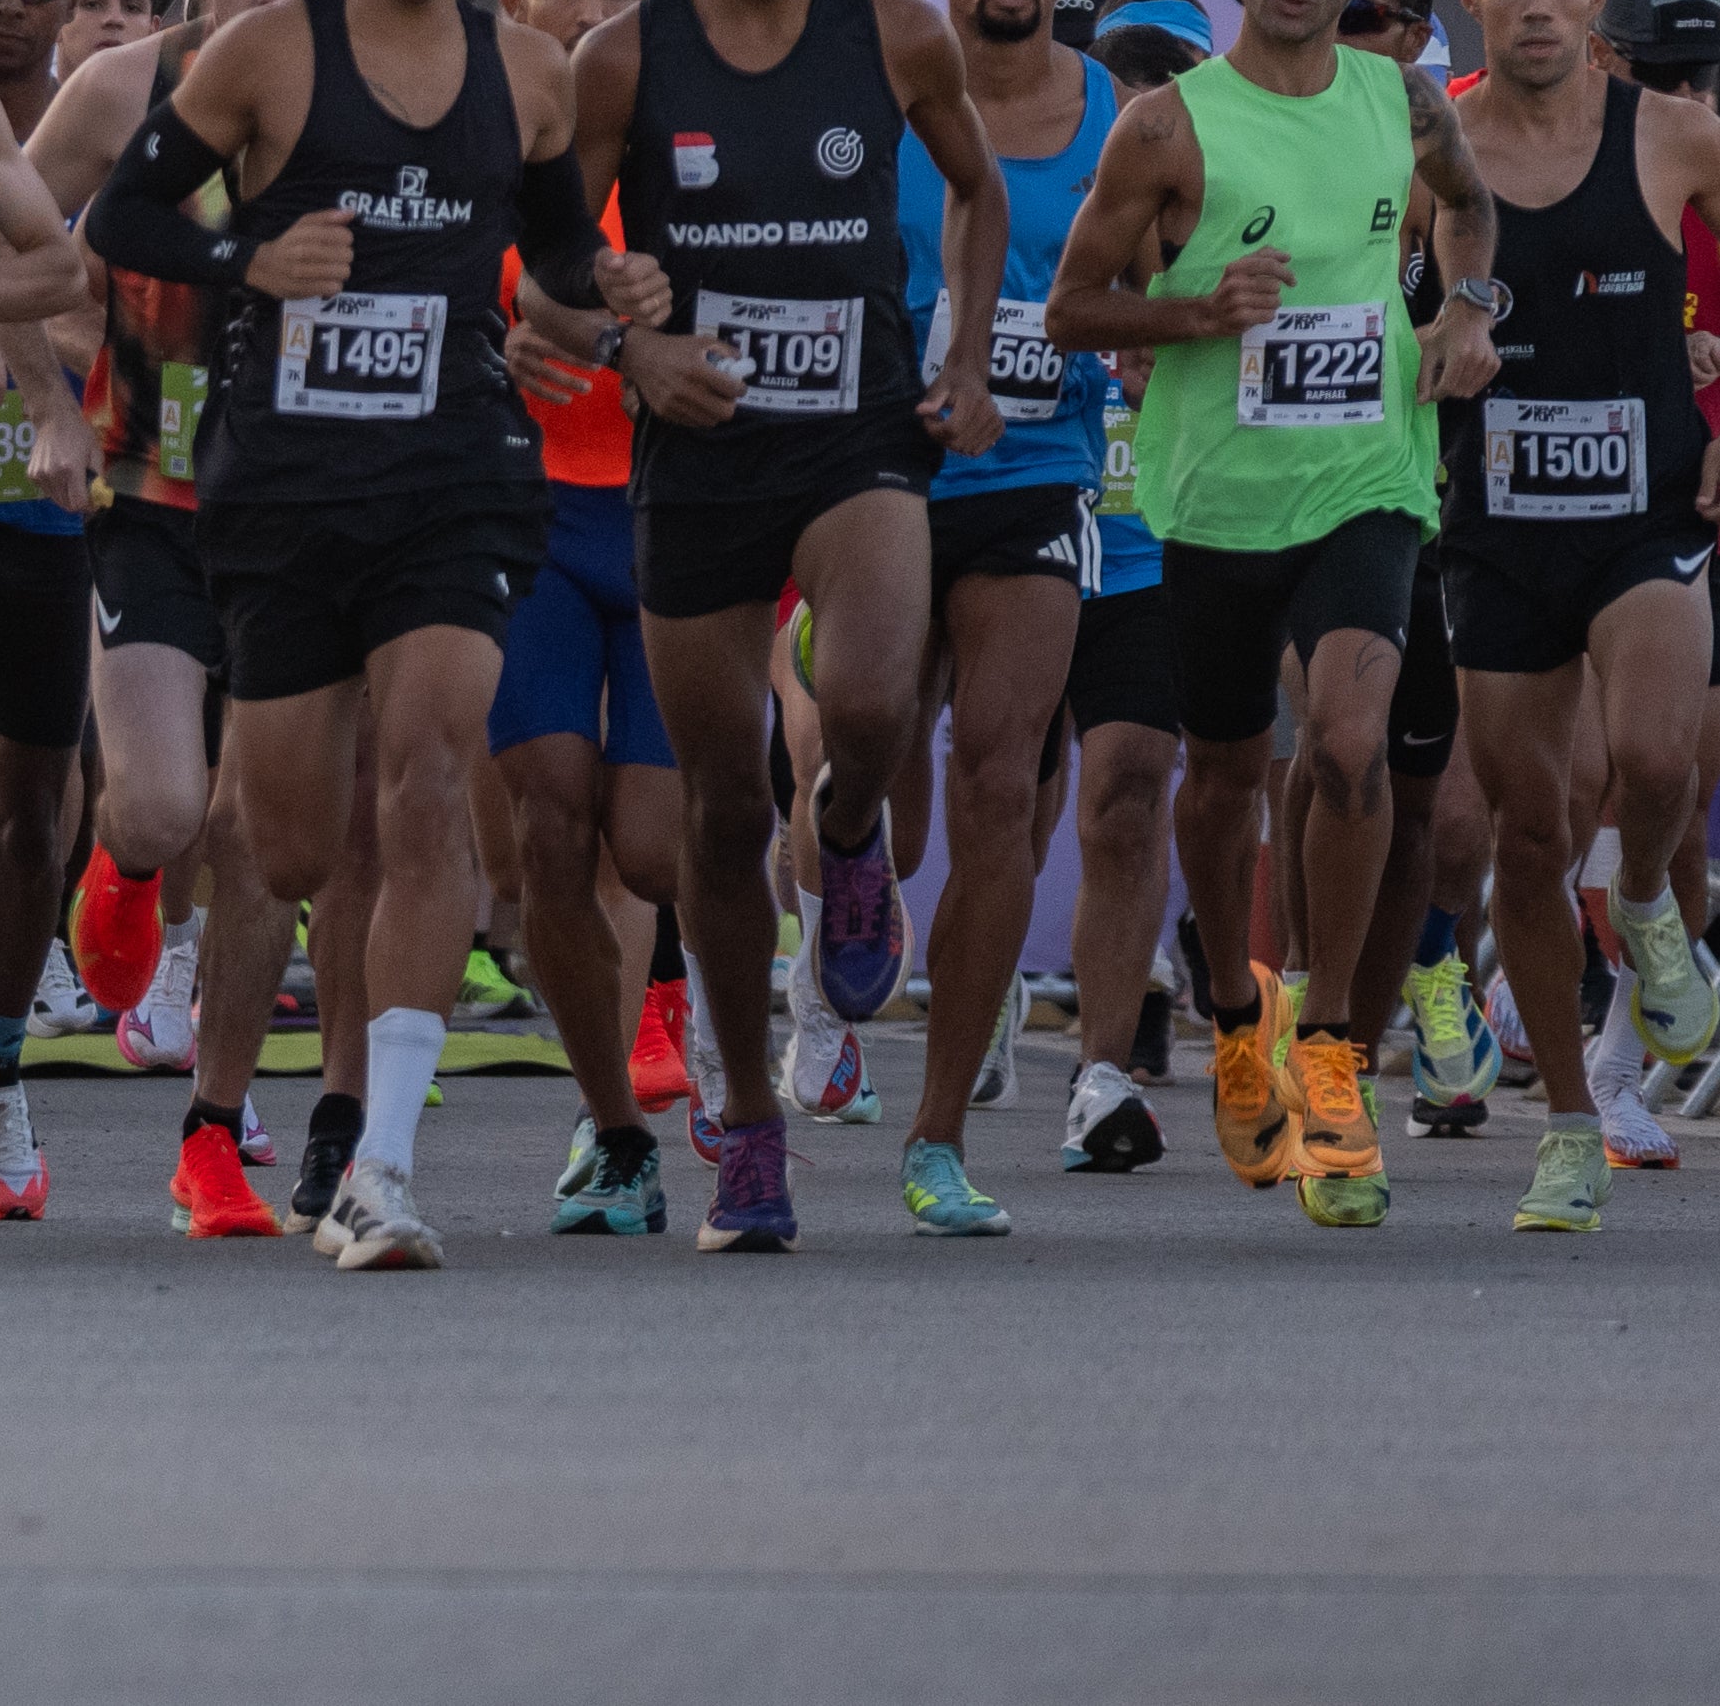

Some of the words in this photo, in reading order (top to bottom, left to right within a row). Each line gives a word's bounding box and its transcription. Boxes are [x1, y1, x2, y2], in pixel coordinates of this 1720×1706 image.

[339, 190, 402, 221] GRAE
[409, 198, 473, 222] TEAM
[667, 222, 784, 247] VOANDO
[788, 217, 869, 243] BAIXO
[287, 323, 308, 349] A
[320, 326, 426, 379] 1495
[729, 328, 842, 376] 1109
[989, 335, 1064, 383] 566
[1277, 339, 1380, 387] 1222
[286, 368, 302, 382] 7K
[759, 375, 800, 388] MATEUS
[1305, 387, 1348, 401] RAPHAEL
[1520, 434, 1628, 479] 1500
[1492, 476, 1507, 488] 7K
